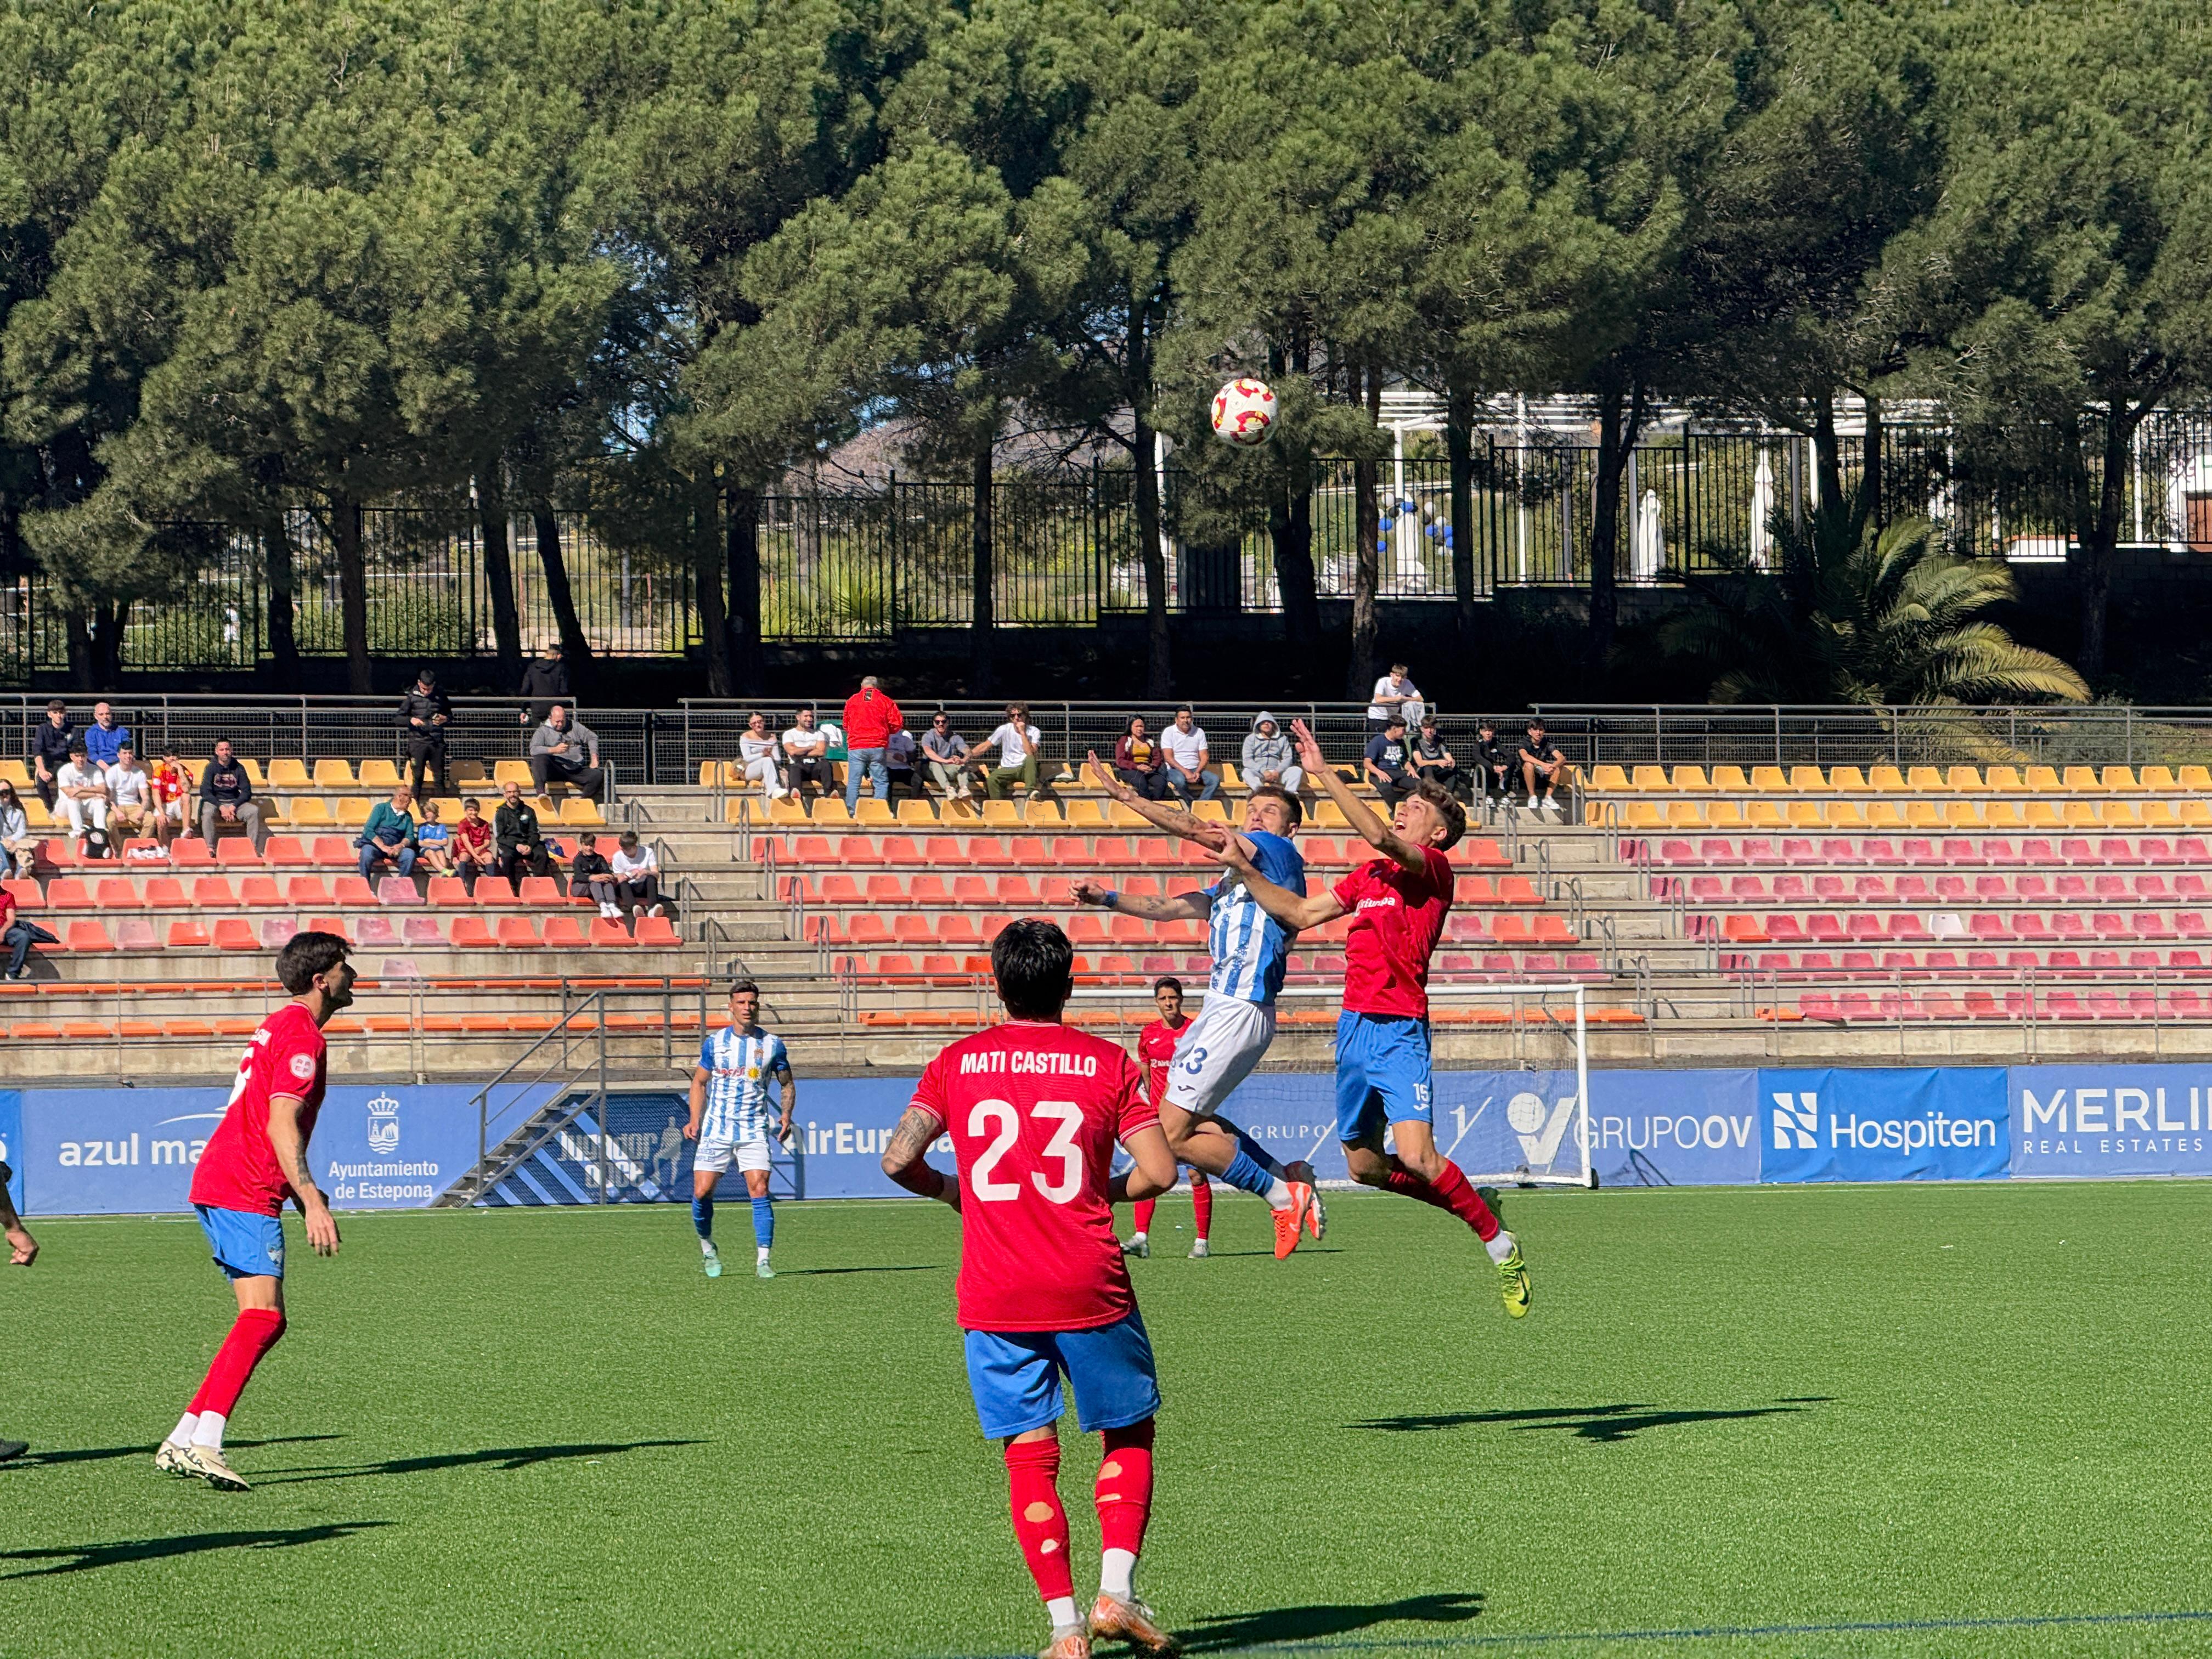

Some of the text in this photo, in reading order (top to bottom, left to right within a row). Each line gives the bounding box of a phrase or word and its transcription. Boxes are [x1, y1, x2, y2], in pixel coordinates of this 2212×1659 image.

[960, 1051, 1097, 1077] MATI CASTILLO
[1413, 1083, 1430, 1102] 15
[1249, 1125, 1327, 1139] GRUPO
[1830, 1111, 1996, 1155] Hospiten
[59, 1133, 138, 1166] azul
[968, 1099, 1084, 1204] 23
[2023, 1138, 2203, 1154] REAL ESTATES
[329, 1160, 439, 1181] Ayuntamiento
[335, 1182, 433, 1201] de Estepona
